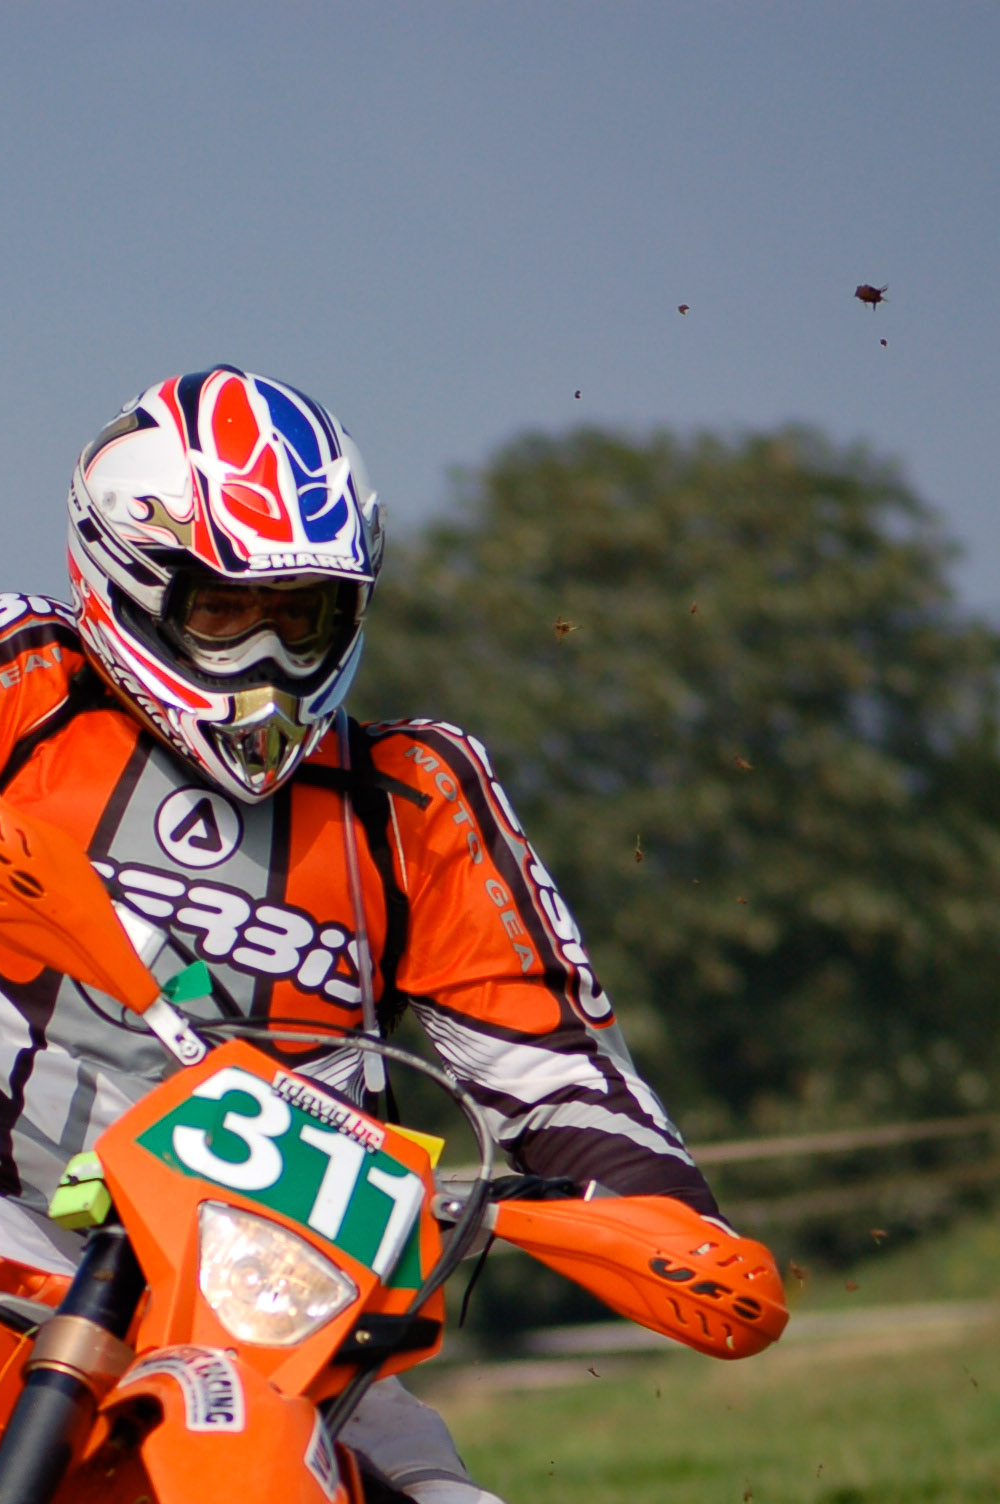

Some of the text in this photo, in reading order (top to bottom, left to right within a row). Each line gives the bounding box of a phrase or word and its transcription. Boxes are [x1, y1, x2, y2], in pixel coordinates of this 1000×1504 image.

[248, 553, 363, 573] SHARK
[404, 746, 536, 975] MOTO GEA
[172, 1067, 424, 1285] 311
